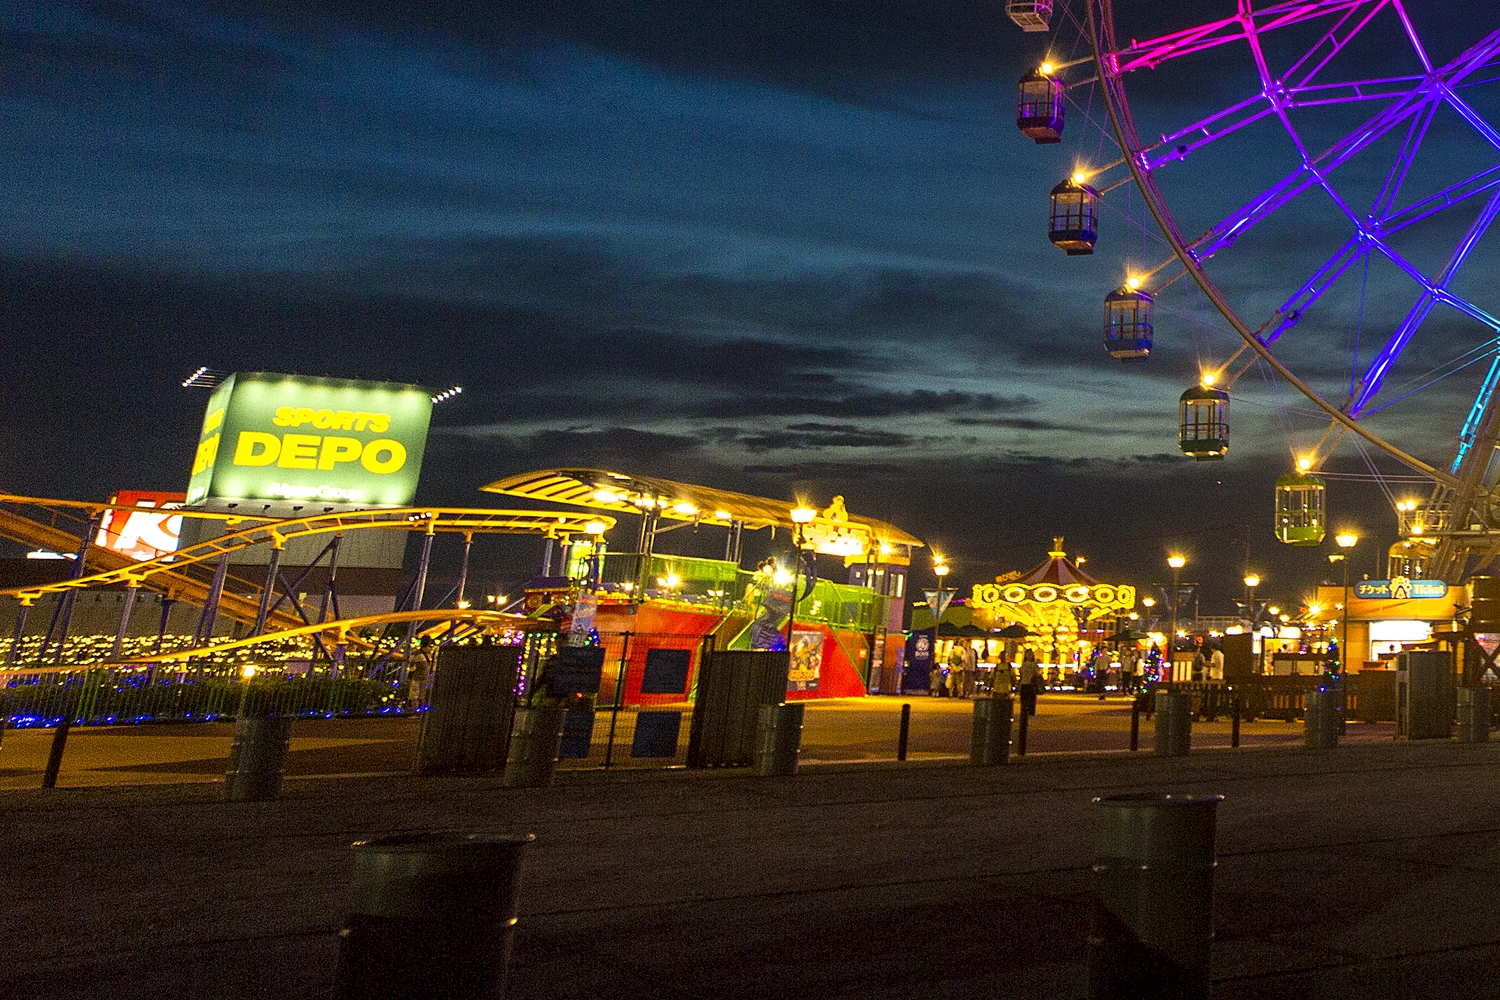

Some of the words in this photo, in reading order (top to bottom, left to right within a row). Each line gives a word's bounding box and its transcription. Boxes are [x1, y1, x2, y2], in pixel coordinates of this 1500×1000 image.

[272, 406, 391, 433] SPORTS
[233, 431, 407, 475] DEPO
[1359, 584, 1389, 595] チケット
[1413, 584, 1445, 595] Ticket
